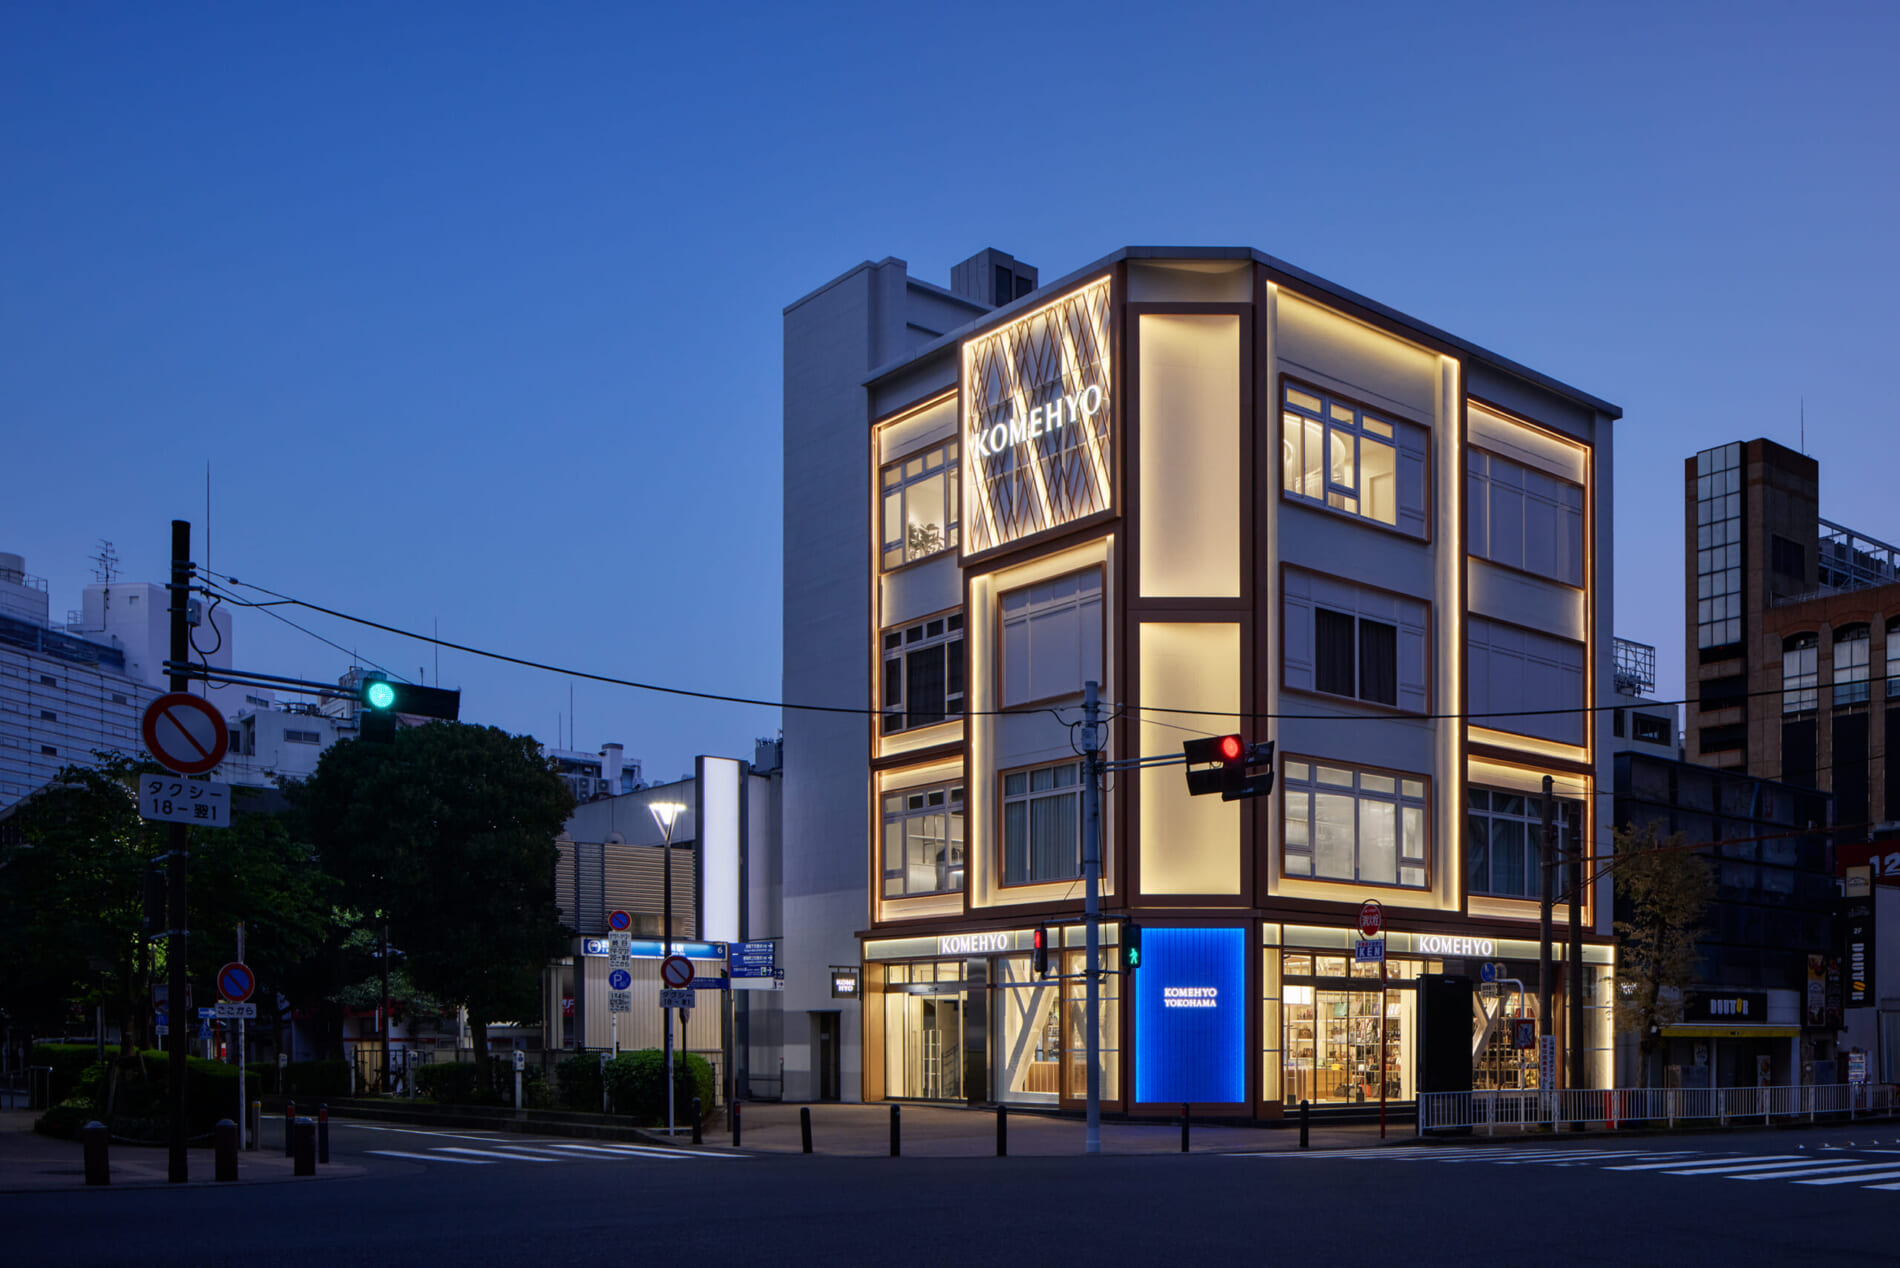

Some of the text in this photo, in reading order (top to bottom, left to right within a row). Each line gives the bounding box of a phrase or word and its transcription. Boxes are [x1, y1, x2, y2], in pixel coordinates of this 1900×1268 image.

[973, 384, 1102, 460] KOMEHYO
[149, 781, 222, 799] タクシー
[940, 935, 1008, 954] KOMEHYO
[1419, 936, 1493, 956] KOMEHYO
[1164, 986, 1218, 997] KOMEHYO
[217, 1006, 254, 1016] ここから
[1163, 998, 1217, 1008] YOKOHAMA
